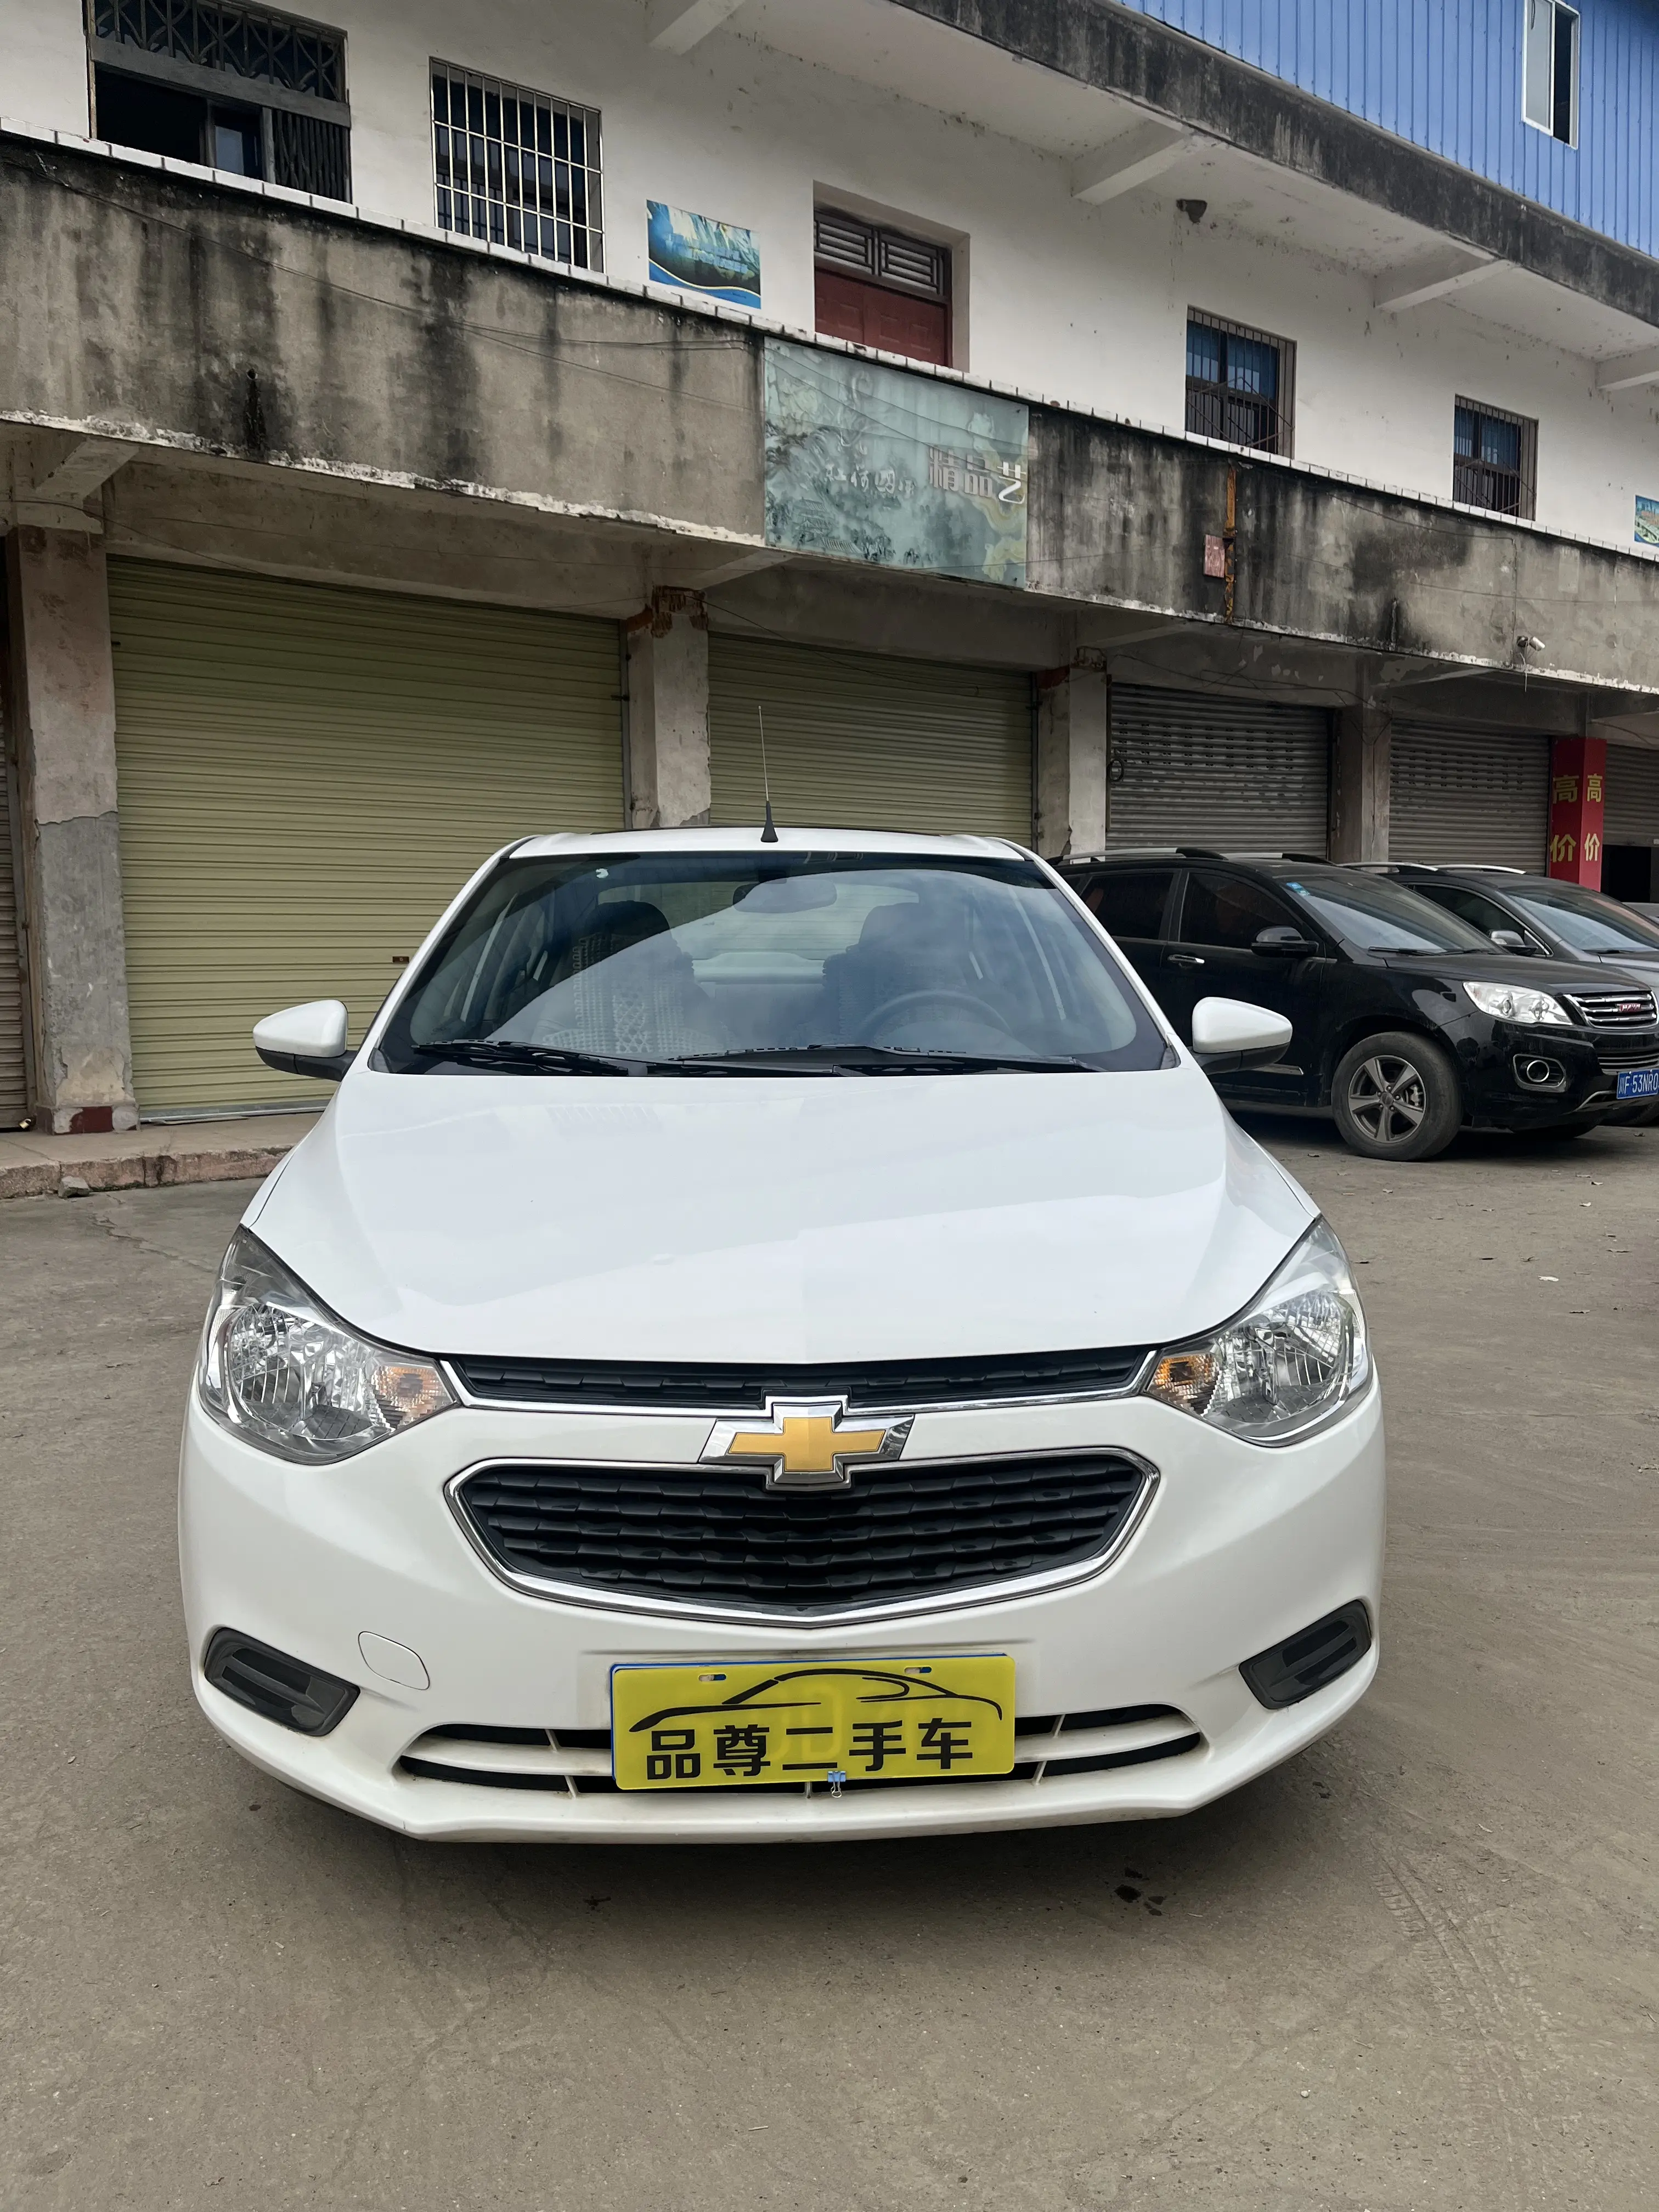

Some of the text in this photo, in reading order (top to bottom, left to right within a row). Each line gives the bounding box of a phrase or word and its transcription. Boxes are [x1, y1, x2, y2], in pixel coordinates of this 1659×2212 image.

[1550, 775, 1579, 863] 高价
[1584, 773, 1603, 862] 高价
[647, 1717, 973, 1780] 品尊二手车
